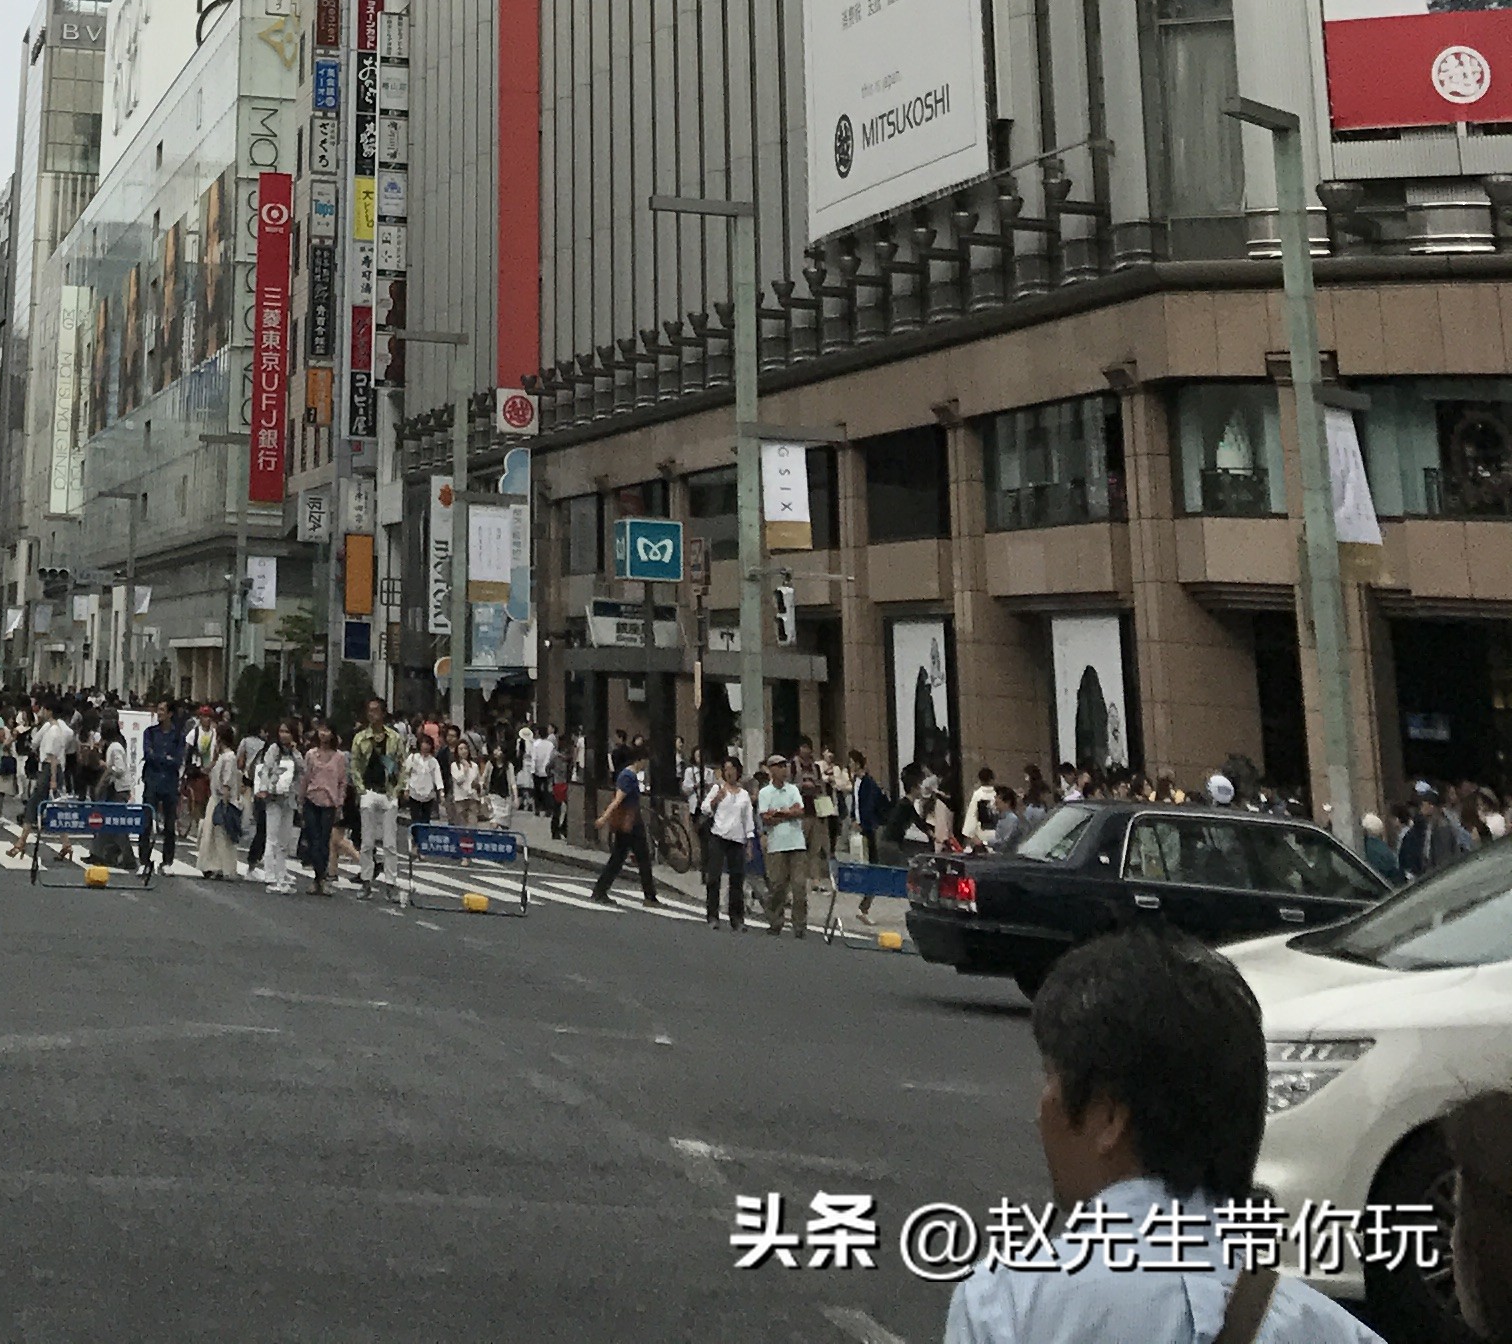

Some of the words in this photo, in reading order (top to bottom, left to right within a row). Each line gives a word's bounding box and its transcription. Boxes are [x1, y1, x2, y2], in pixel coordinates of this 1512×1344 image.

[862, 83, 951, 151] MITSUKOSHI
[257, 286, 282, 472] 三菱東京UFJ銀行
